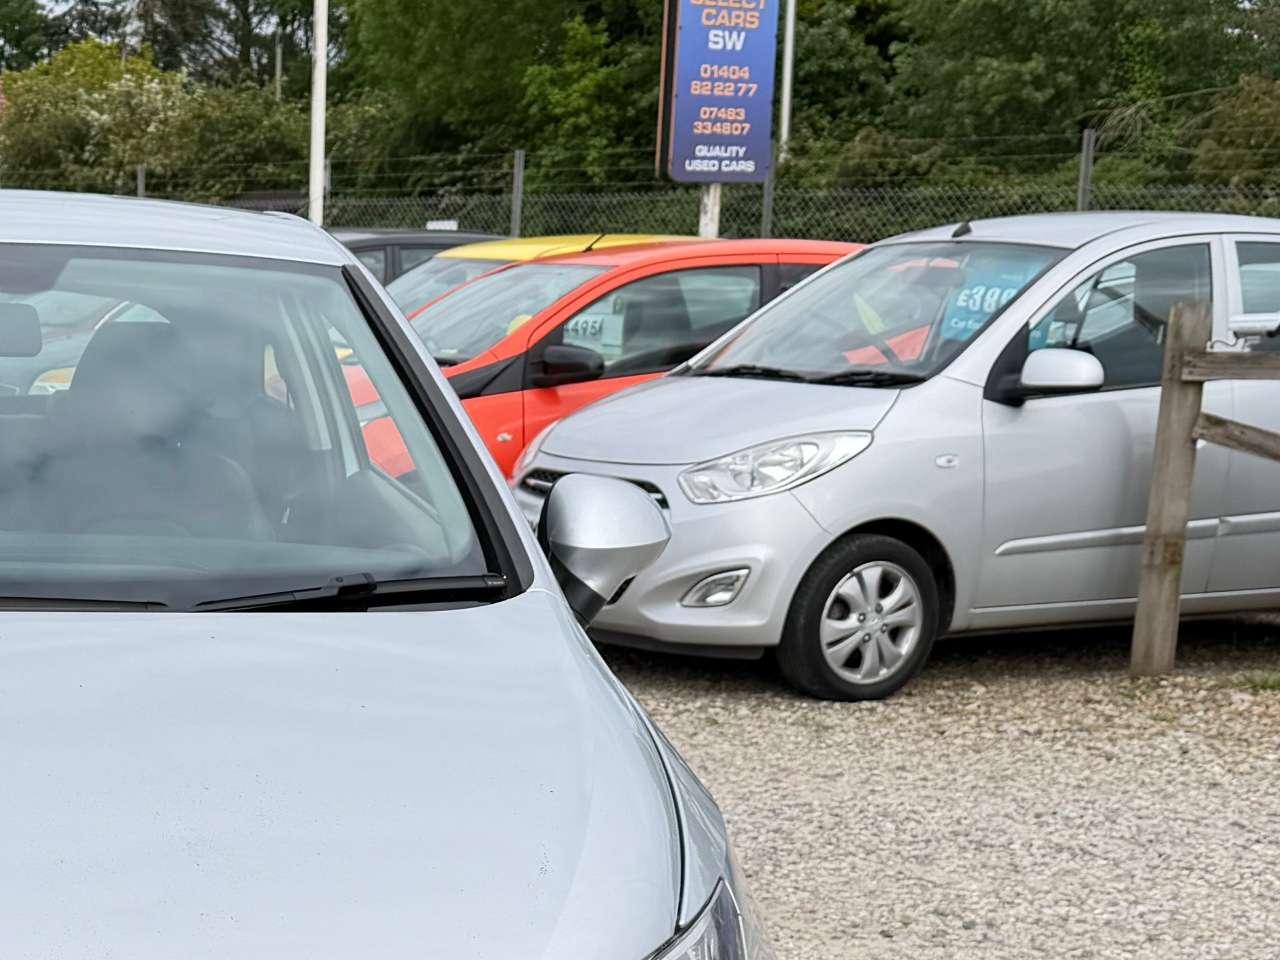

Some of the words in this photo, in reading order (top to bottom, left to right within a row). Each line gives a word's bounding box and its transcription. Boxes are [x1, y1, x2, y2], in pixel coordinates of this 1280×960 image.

[701, 9, 760, 28] CARS
[708, 30, 745, 51] SW
[700, 64, 749, 79] 01404
[700, 106, 745, 120] 07483
[693, 121, 751, 135] 334807
[695, 145, 746, 157] QUALITY
[685, 159, 719, 171] USED
[721, 160, 755, 172] CARS
